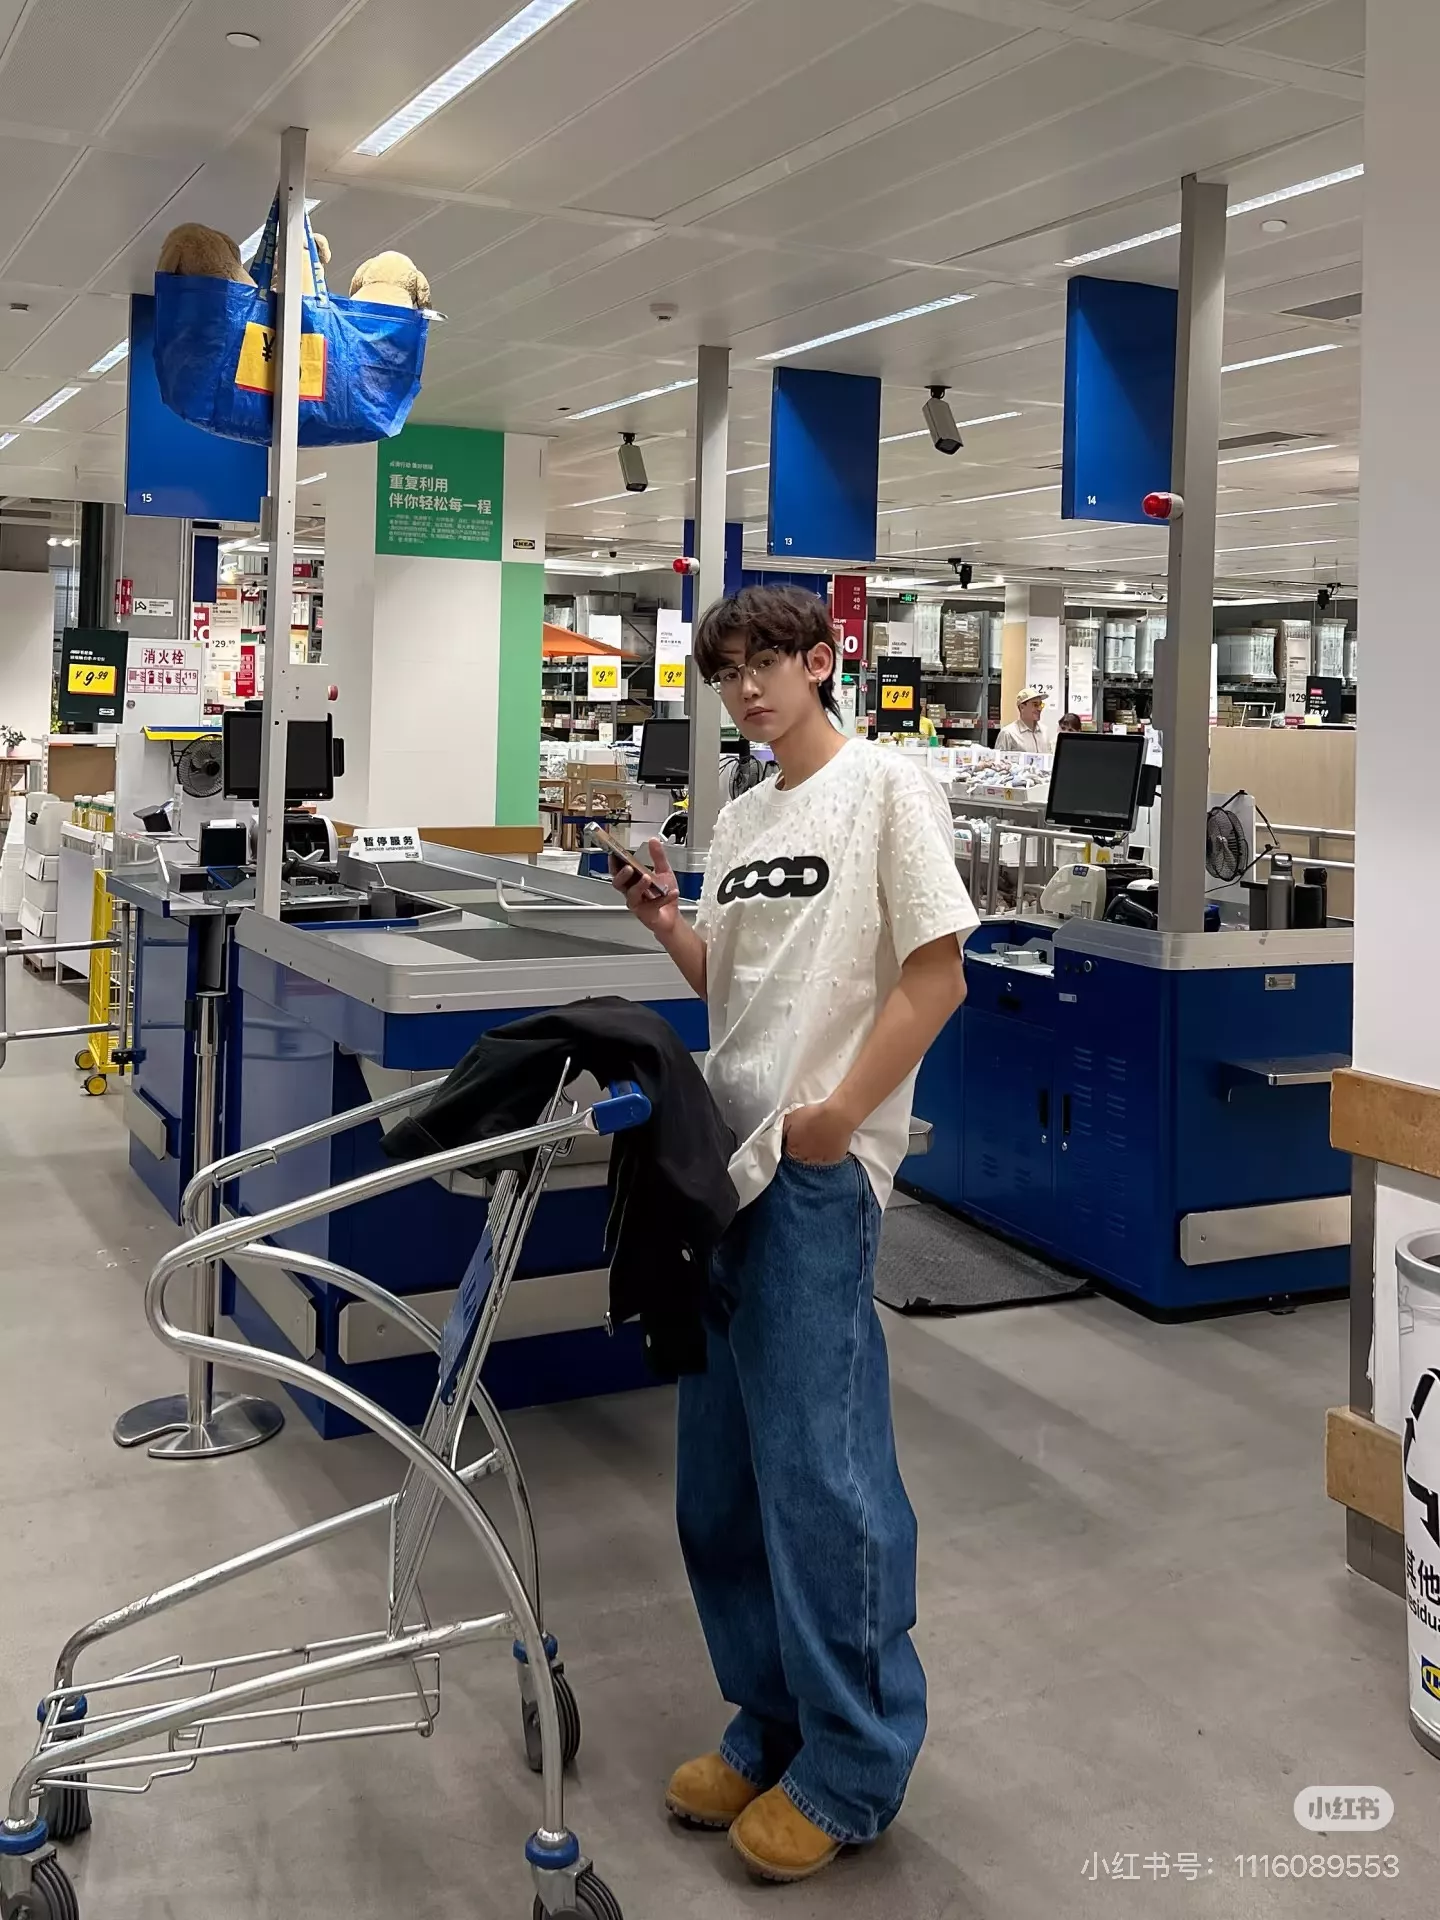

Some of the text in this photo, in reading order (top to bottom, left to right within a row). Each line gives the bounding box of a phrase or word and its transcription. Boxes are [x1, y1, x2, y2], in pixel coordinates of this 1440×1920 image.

[389, 474, 448, 493] 重复利用
[141, 493, 153, 503] 15
[389, 492, 492, 515] 伴你轻松每一程
[1087, 495, 1097, 505] 14
[784, 537, 793, 546] 13
[144, 649, 184, 666] 消火栓
[184, 672, 197, 680] 119
[595, 669, 614, 683] ¥9.99
[664, 671, 683, 683] ¥9.99
[363, 836, 414, 847] 暂停服务
